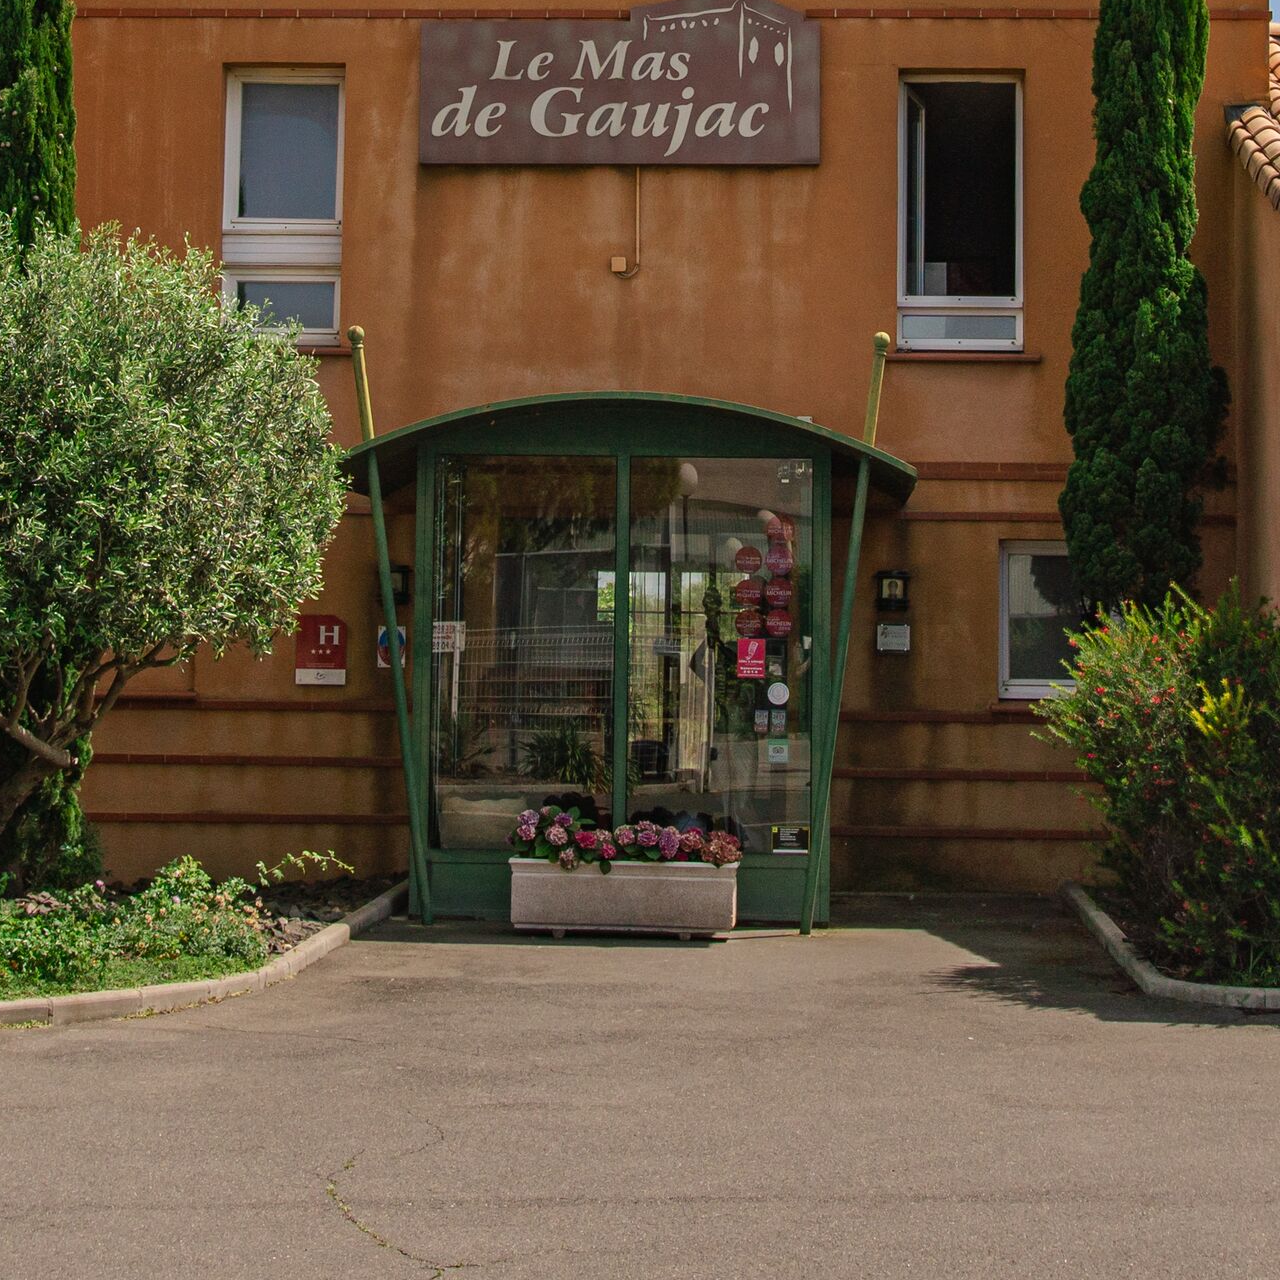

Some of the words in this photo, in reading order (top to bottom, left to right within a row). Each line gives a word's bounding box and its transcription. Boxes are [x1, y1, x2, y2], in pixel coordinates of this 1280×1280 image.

[489, 40, 554, 81] Le
[571, 39, 691, 81] Mas
[431, 84, 507, 137] de
[530, 86, 770, 157] Gaujac
[319, 625, 340, 646] H
